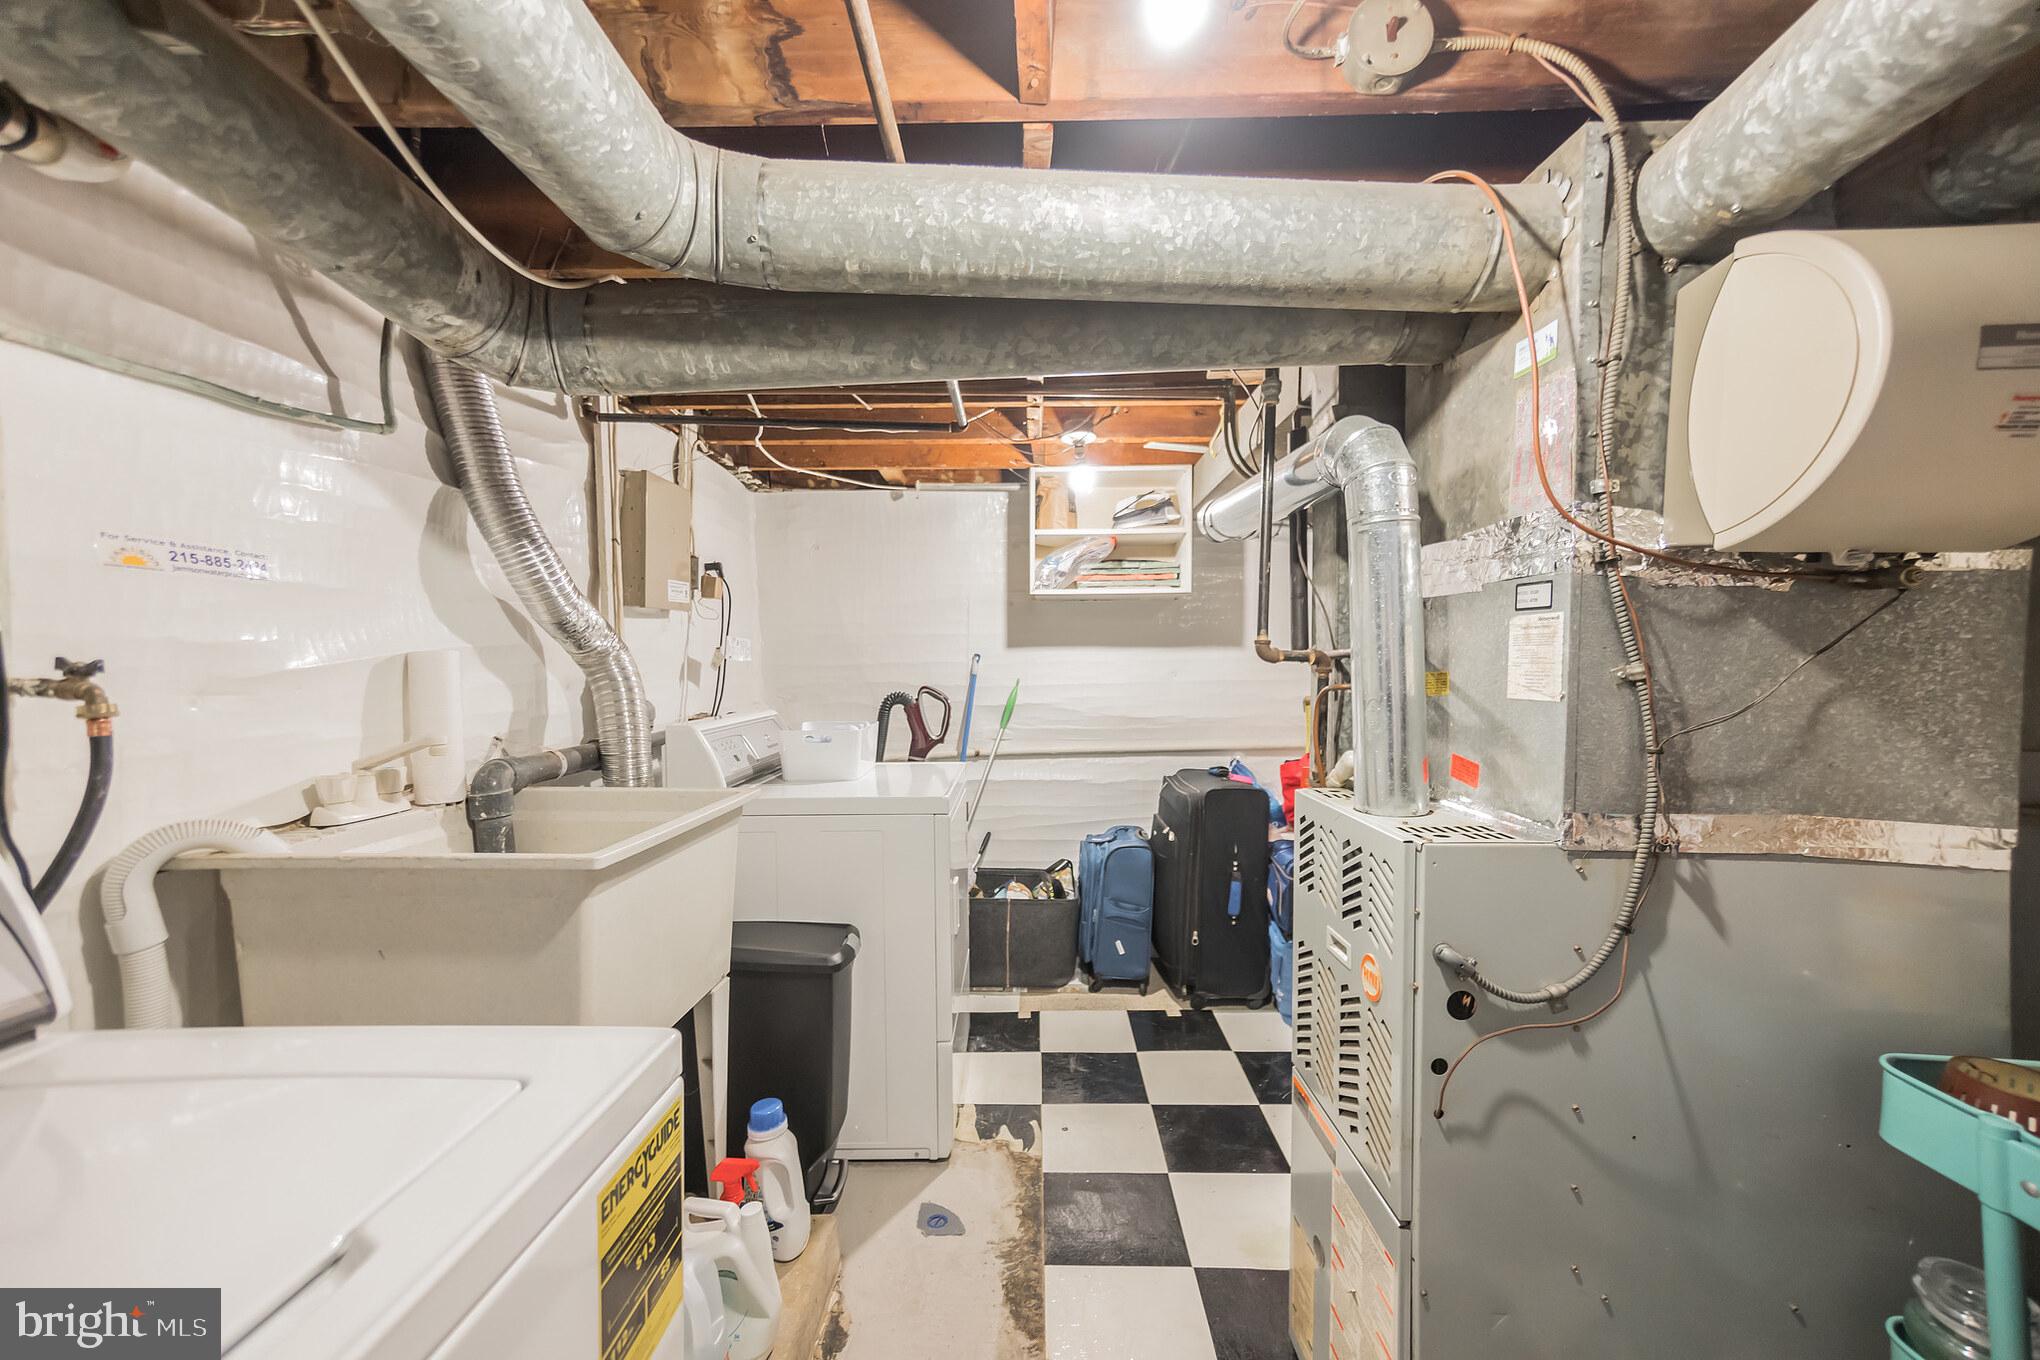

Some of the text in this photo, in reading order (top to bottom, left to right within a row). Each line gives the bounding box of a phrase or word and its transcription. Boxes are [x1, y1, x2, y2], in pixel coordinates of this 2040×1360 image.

[99, 531, 119, 540] For
[123, 535, 166, 546] Service
[601, 1107, 681, 1225] ENERGYGUIDE
